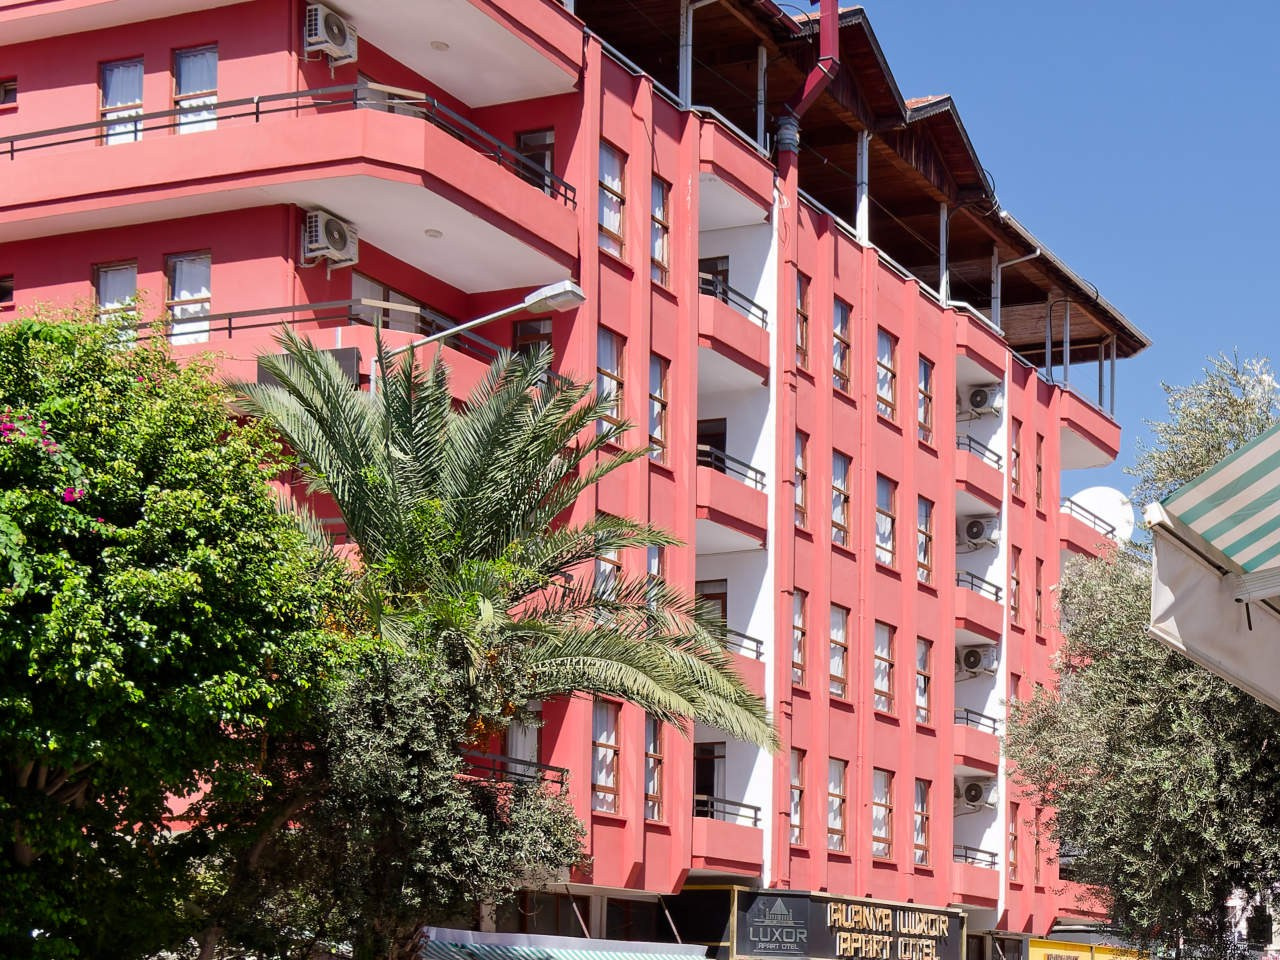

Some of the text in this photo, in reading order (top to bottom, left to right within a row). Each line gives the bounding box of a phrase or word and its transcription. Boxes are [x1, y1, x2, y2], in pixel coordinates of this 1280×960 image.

[827, 902, 949, 937] ALANYA LUXOR
[749, 926, 808, 943] LUXOR
[836, 931, 893, 960] APART
[757, 942, 800, 951] APART OTEL
